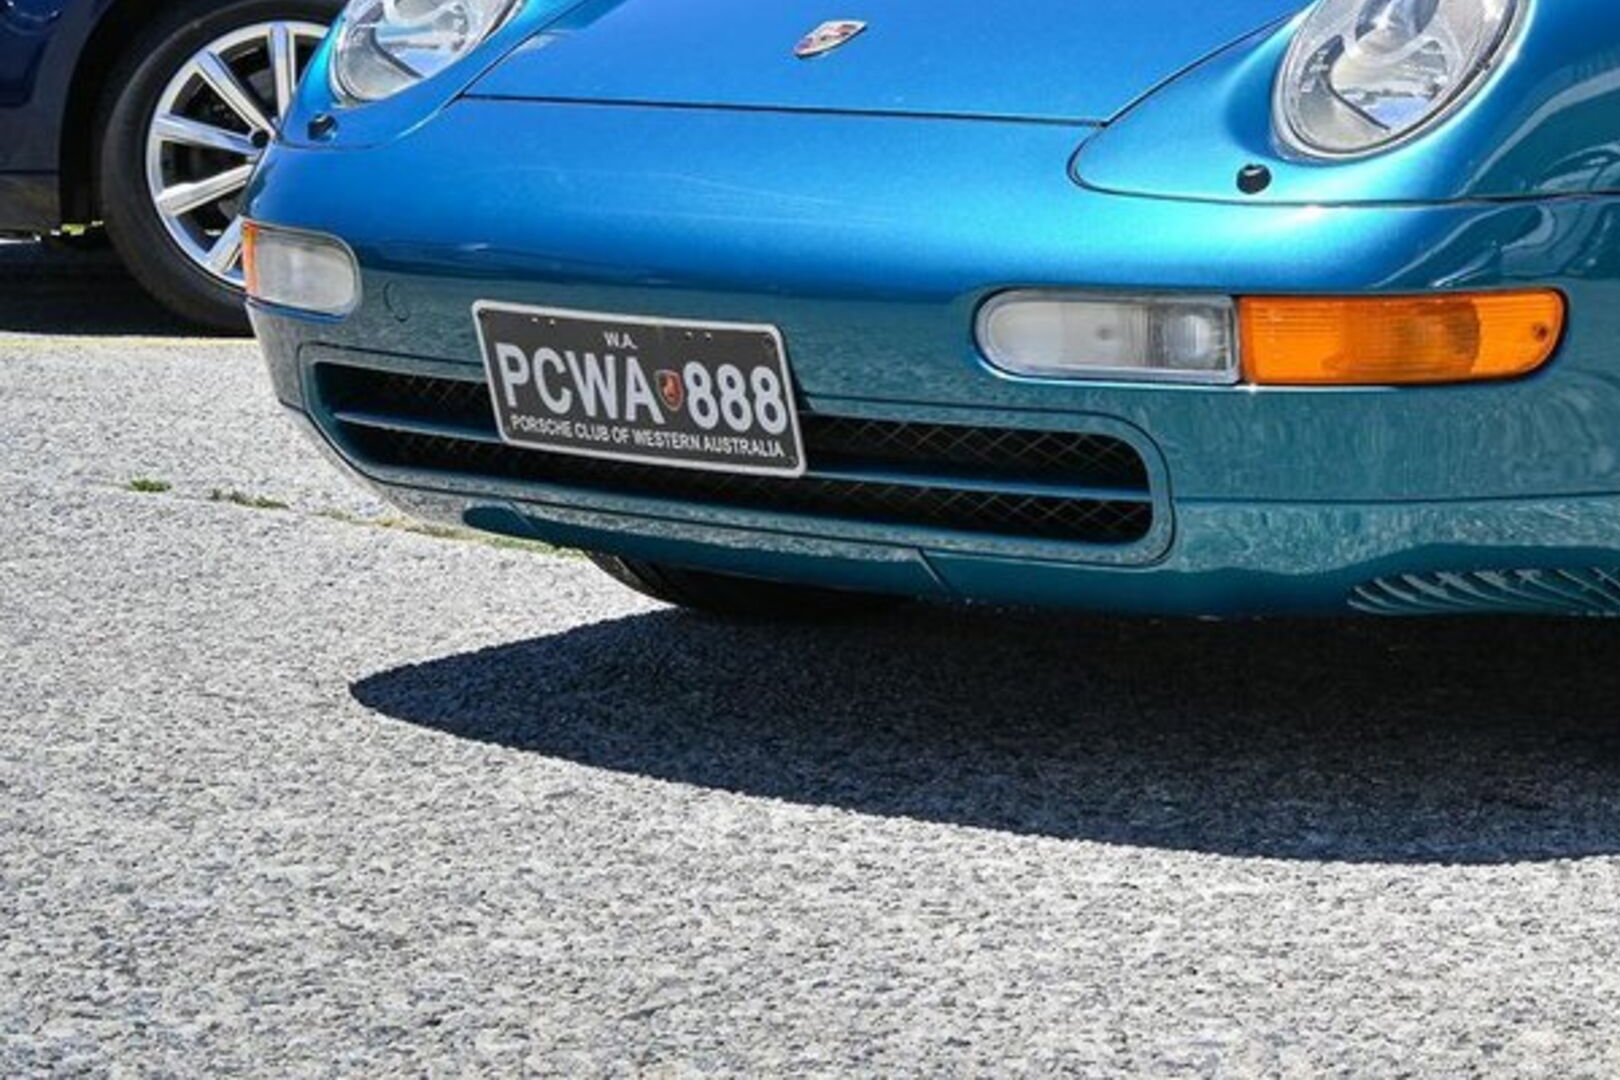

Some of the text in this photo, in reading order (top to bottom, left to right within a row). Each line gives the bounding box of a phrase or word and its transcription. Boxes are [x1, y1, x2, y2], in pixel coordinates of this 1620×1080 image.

[496, 343, 787, 435] PCWA 888
[510, 414, 786, 457] PORSCHE CLUB OF WESTERN AUSTRALIA
